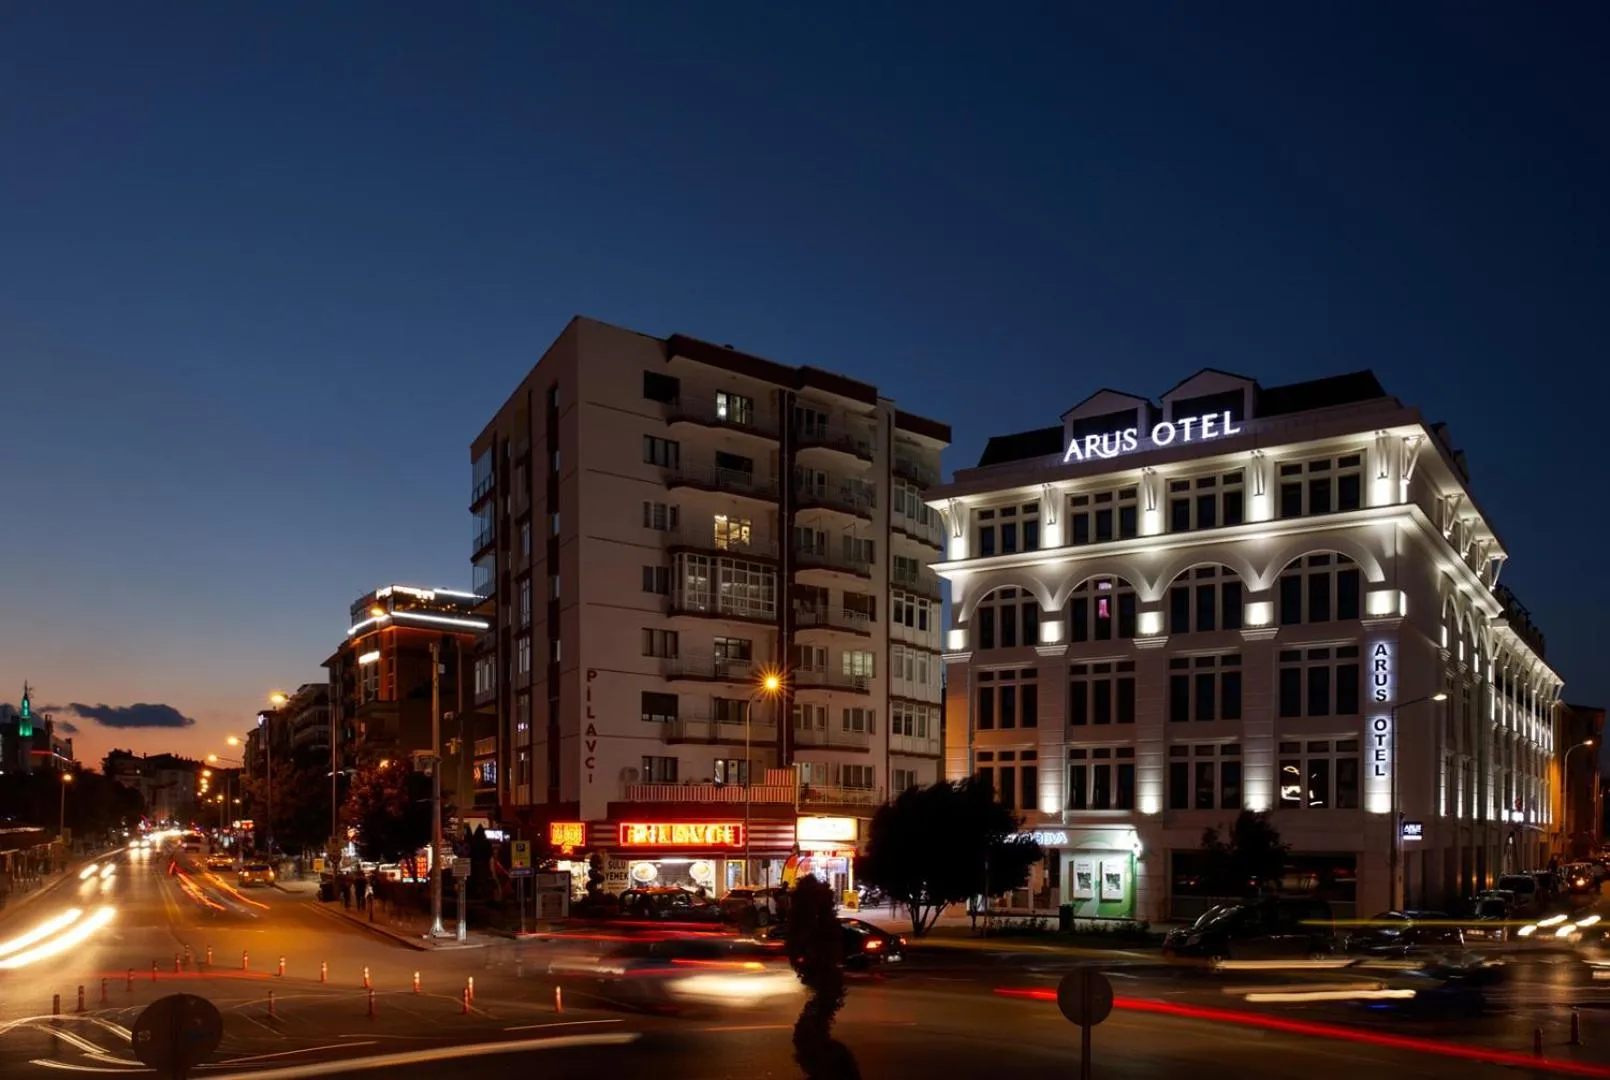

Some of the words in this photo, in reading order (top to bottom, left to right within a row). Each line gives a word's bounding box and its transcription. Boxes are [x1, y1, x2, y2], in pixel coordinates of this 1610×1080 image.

[1063, 428, 1138, 463] ARUS
[1151, 411, 1241, 446] OTEL
[1374, 643, 1388, 702] ARUS
[1374, 718, 1388, 776] OTEL
